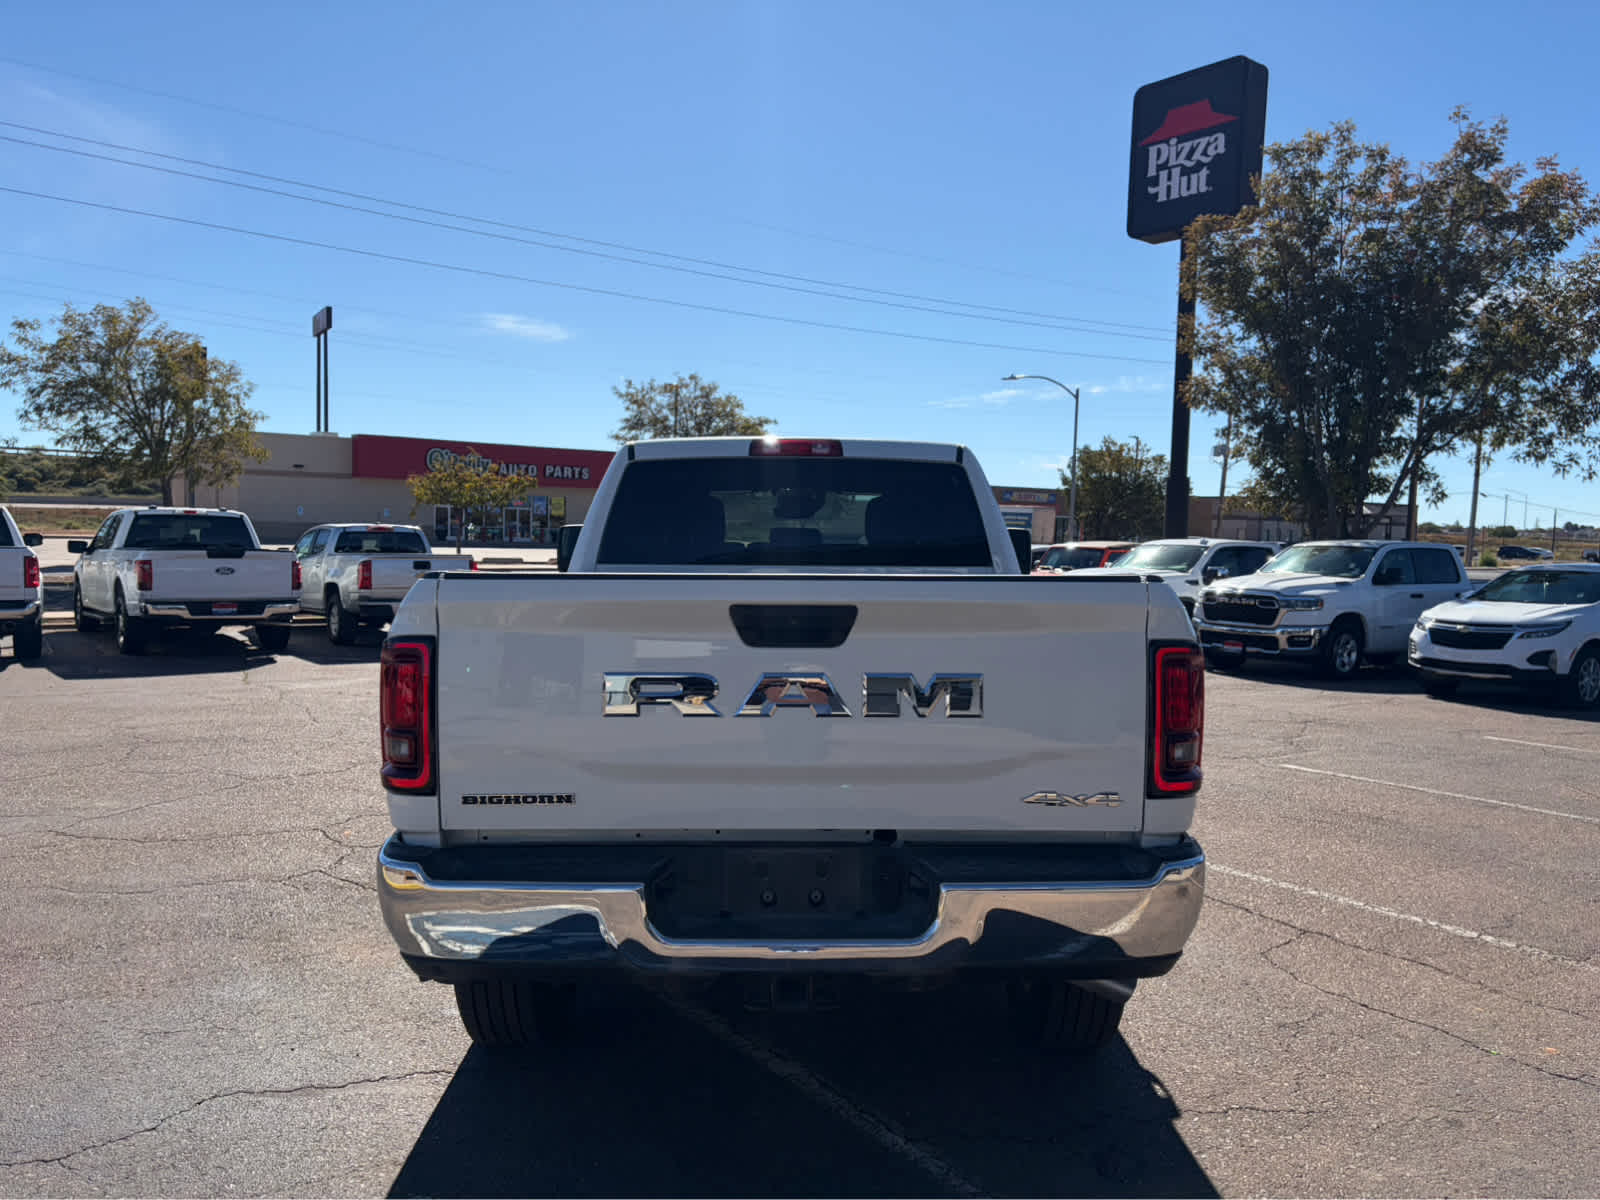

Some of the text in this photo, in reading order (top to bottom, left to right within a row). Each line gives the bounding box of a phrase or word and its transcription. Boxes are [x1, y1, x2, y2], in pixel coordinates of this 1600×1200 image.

[1146, 132, 1226, 177] Pizza
[1147, 165, 1211, 202] Hut
[500, 463, 538, 477] AUTO
[545, 465, 590, 480] PARTS
[602, 672, 985, 718] RAM
[461, 793, 575, 805] BIGHORN
